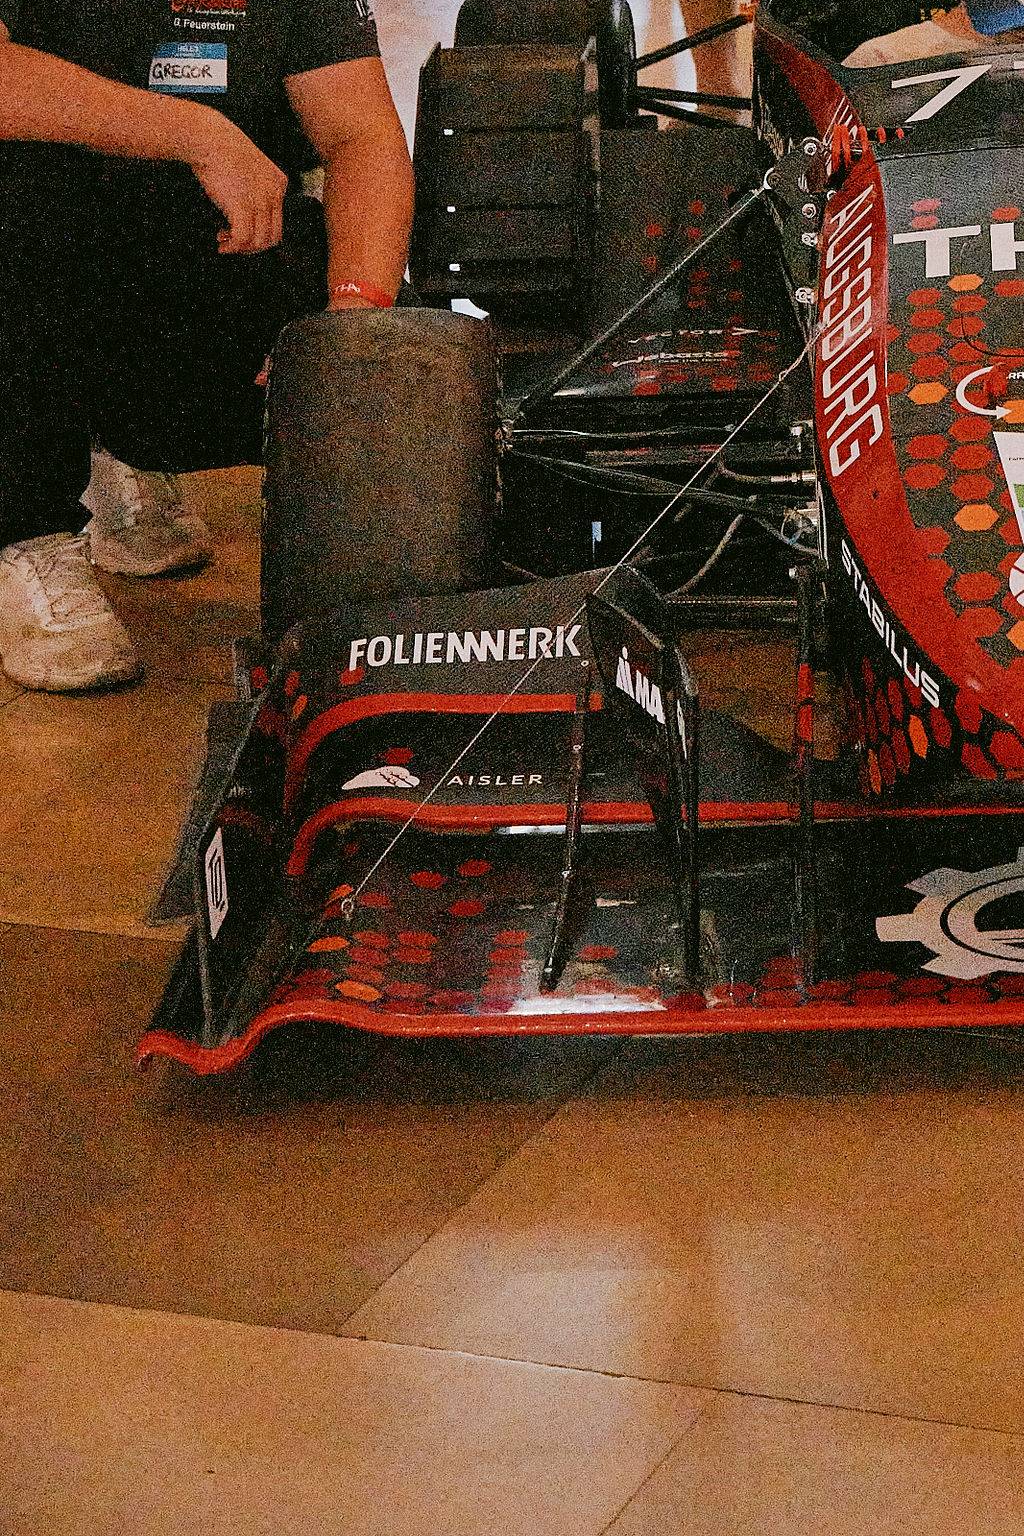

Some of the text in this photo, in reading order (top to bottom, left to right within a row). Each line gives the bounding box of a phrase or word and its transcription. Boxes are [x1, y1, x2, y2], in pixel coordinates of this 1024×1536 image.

[152, 62, 213, 81] GREGOR
[821, 183, 884, 478] AUGSBURG
[841, 538, 940, 708] STABILUS
[348, 624, 582, 672] FOLIENWERK
[446, 774, 543, 786] AISLER
